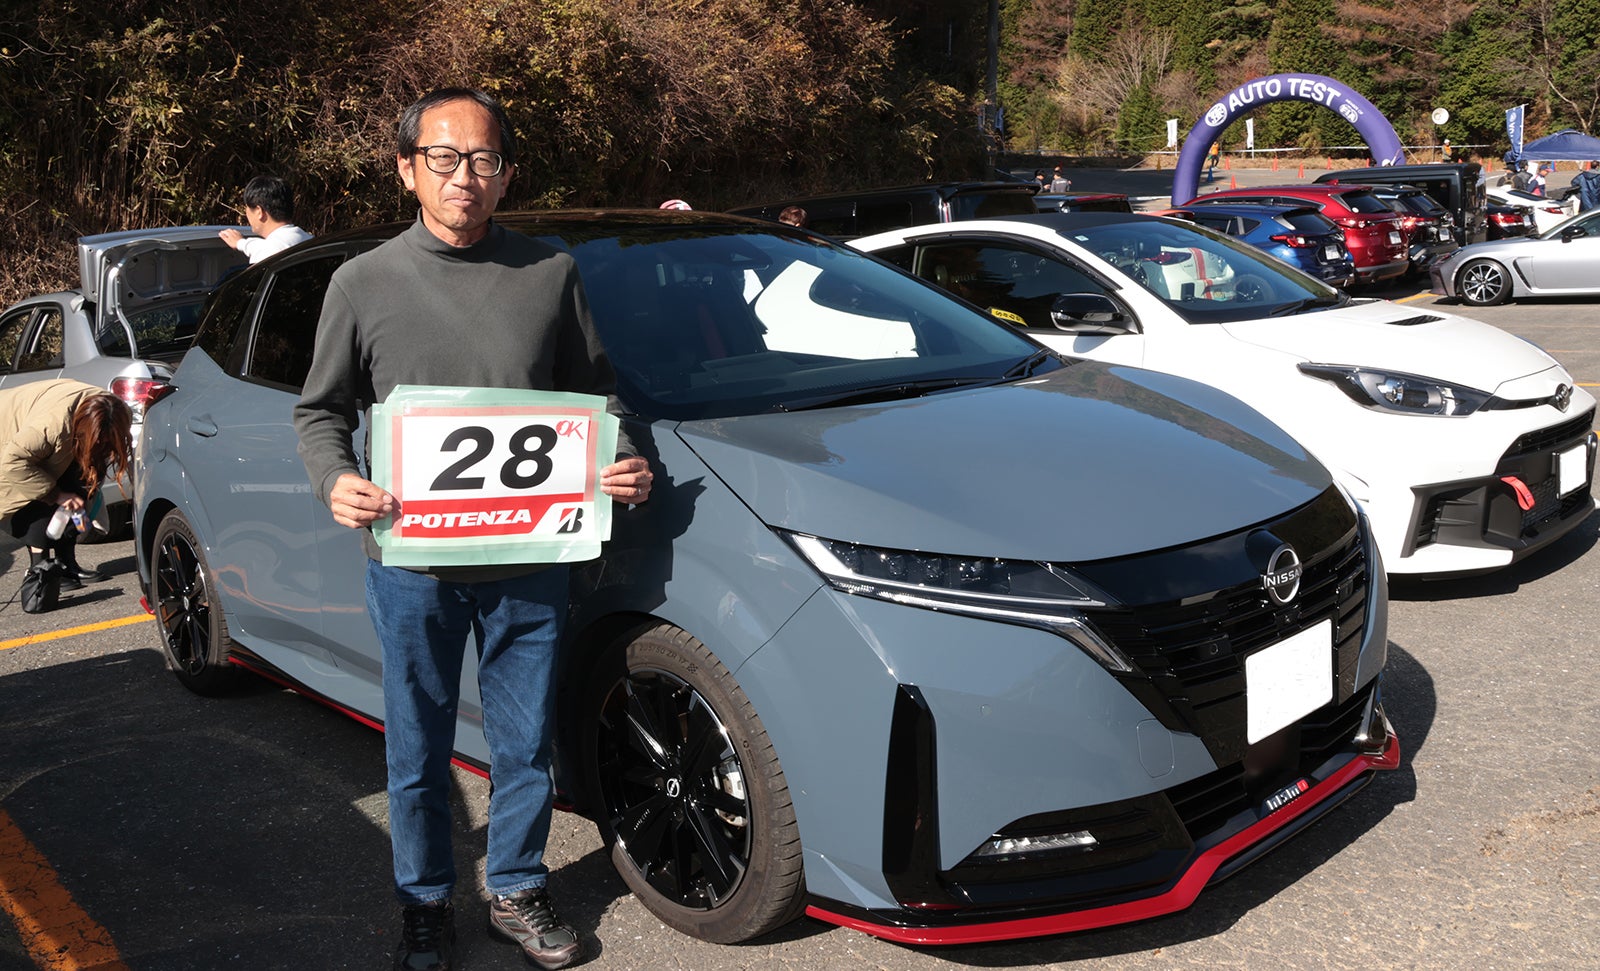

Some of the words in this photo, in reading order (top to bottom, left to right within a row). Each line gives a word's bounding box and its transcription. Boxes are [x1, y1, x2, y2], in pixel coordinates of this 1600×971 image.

[1229, 78, 1281, 112] AUTO
[1287, 78, 1341, 106] TEST
[555, 420, 584, 440] OK
[429, 424, 558, 491] 28
[401, 509, 532, 528] POTENZA
[1266, 567, 1302, 587] NISSA
